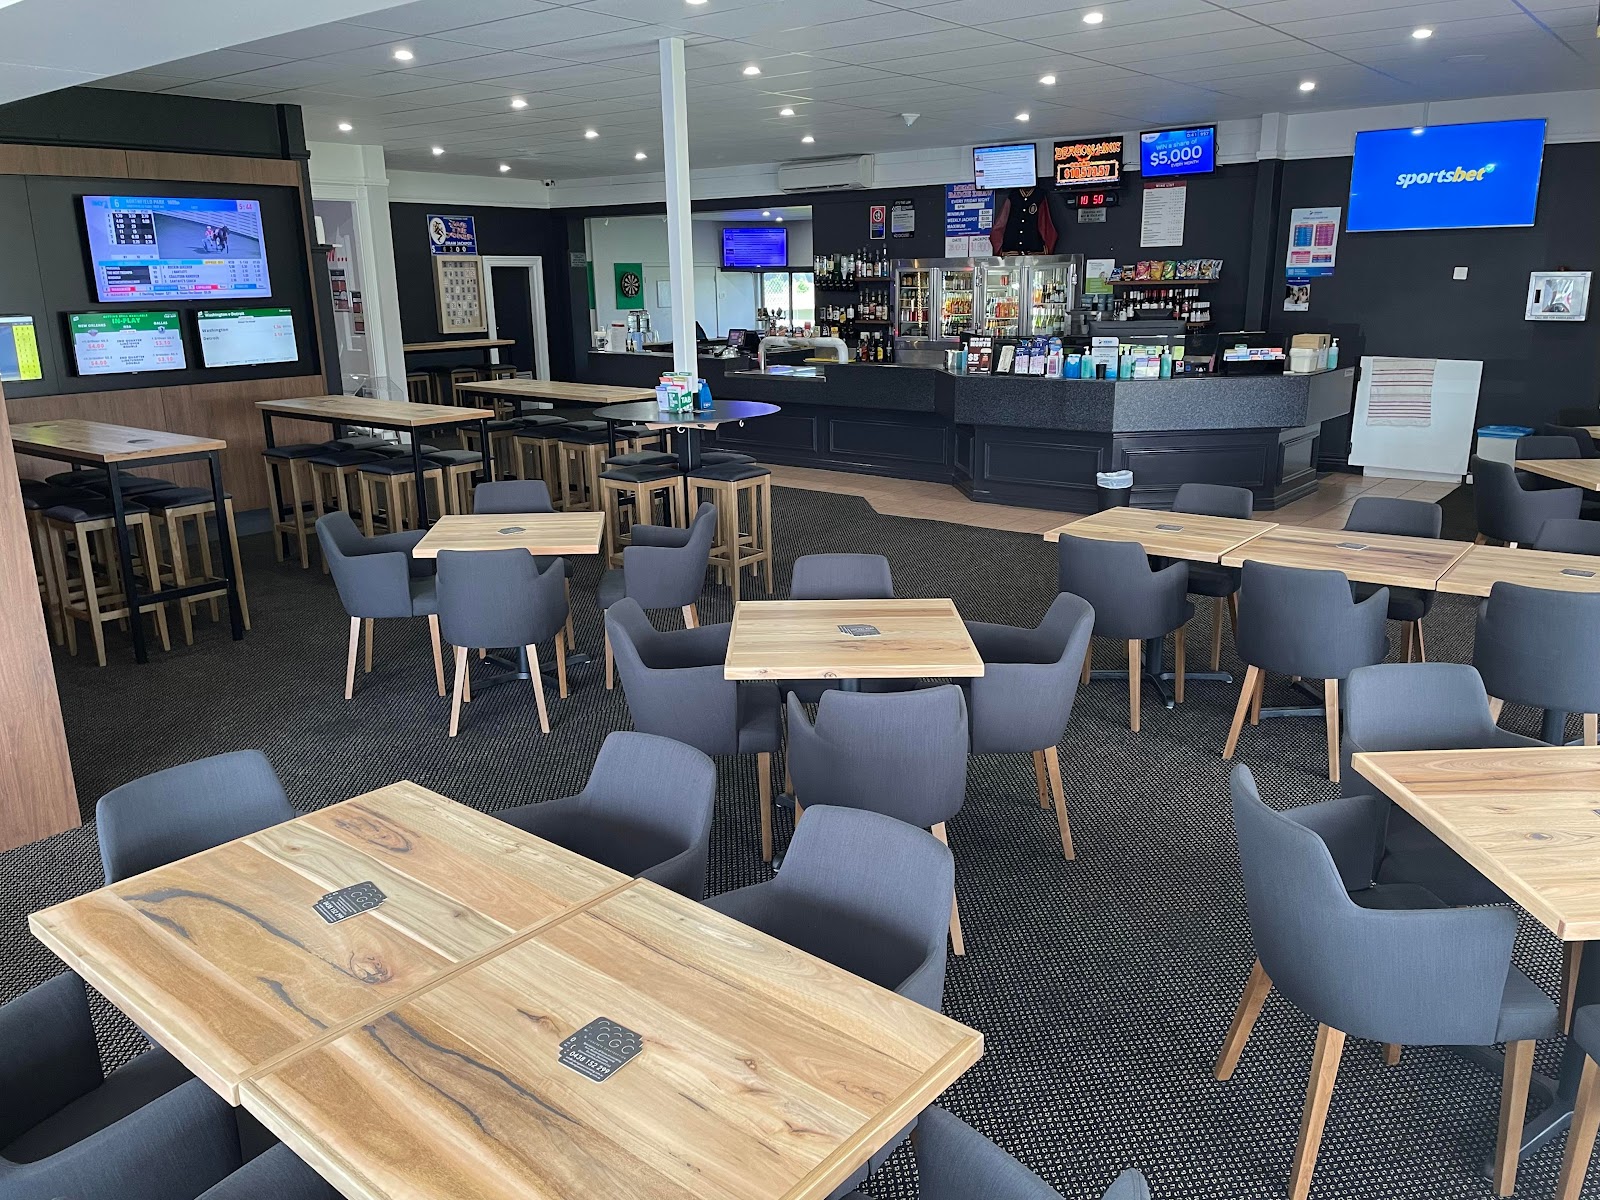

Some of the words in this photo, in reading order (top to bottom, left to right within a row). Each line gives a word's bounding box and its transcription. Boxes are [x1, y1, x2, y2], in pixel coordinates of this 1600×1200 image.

[1173, 140, 1190, 148] share
[1150, 145, 1203, 167] $5,000
[1395, 166, 1487, 189] sportsbet
[114, 199, 120, 208] 6
[1080, 195, 1089, 205] 10
[1093, 194, 1104, 204] 50
[596, 1032, 635, 1055] CGC
[569, 1051, 586, 1062] 0438
[585, 1058, 599, 1069] 152
[596, 1064, 611, 1074] 299
